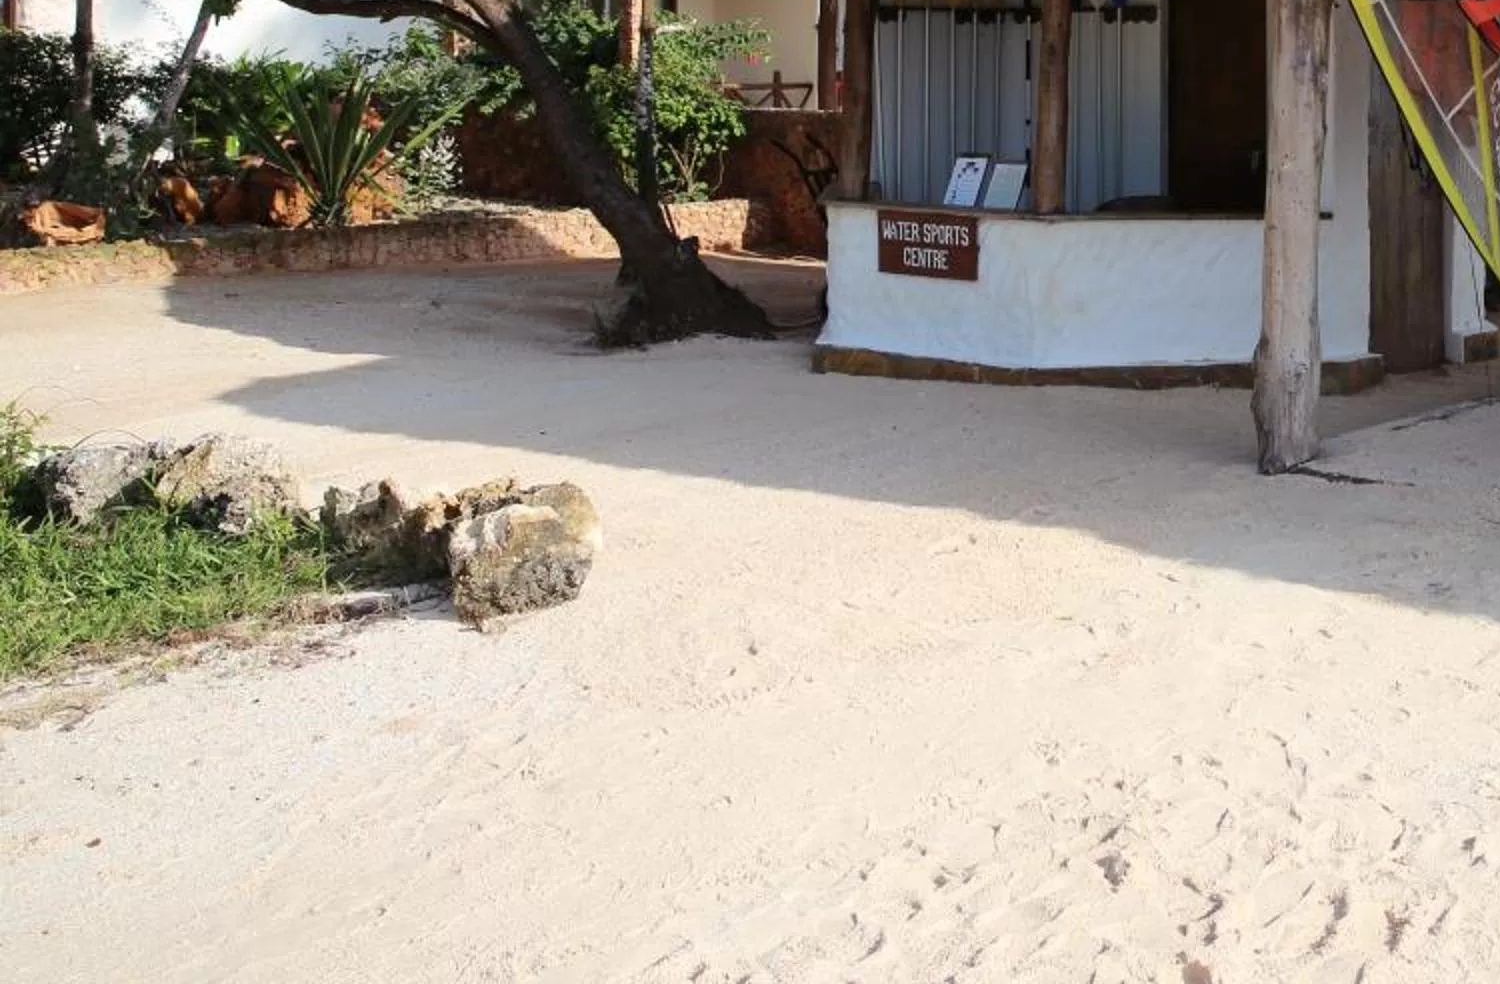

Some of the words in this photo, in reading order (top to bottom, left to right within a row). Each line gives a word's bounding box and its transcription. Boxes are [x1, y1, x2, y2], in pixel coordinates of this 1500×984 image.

[882, 220, 920, 243] WATER
[923, 223, 969, 247] SPORTS
[903, 247, 949, 270] CENTRE
